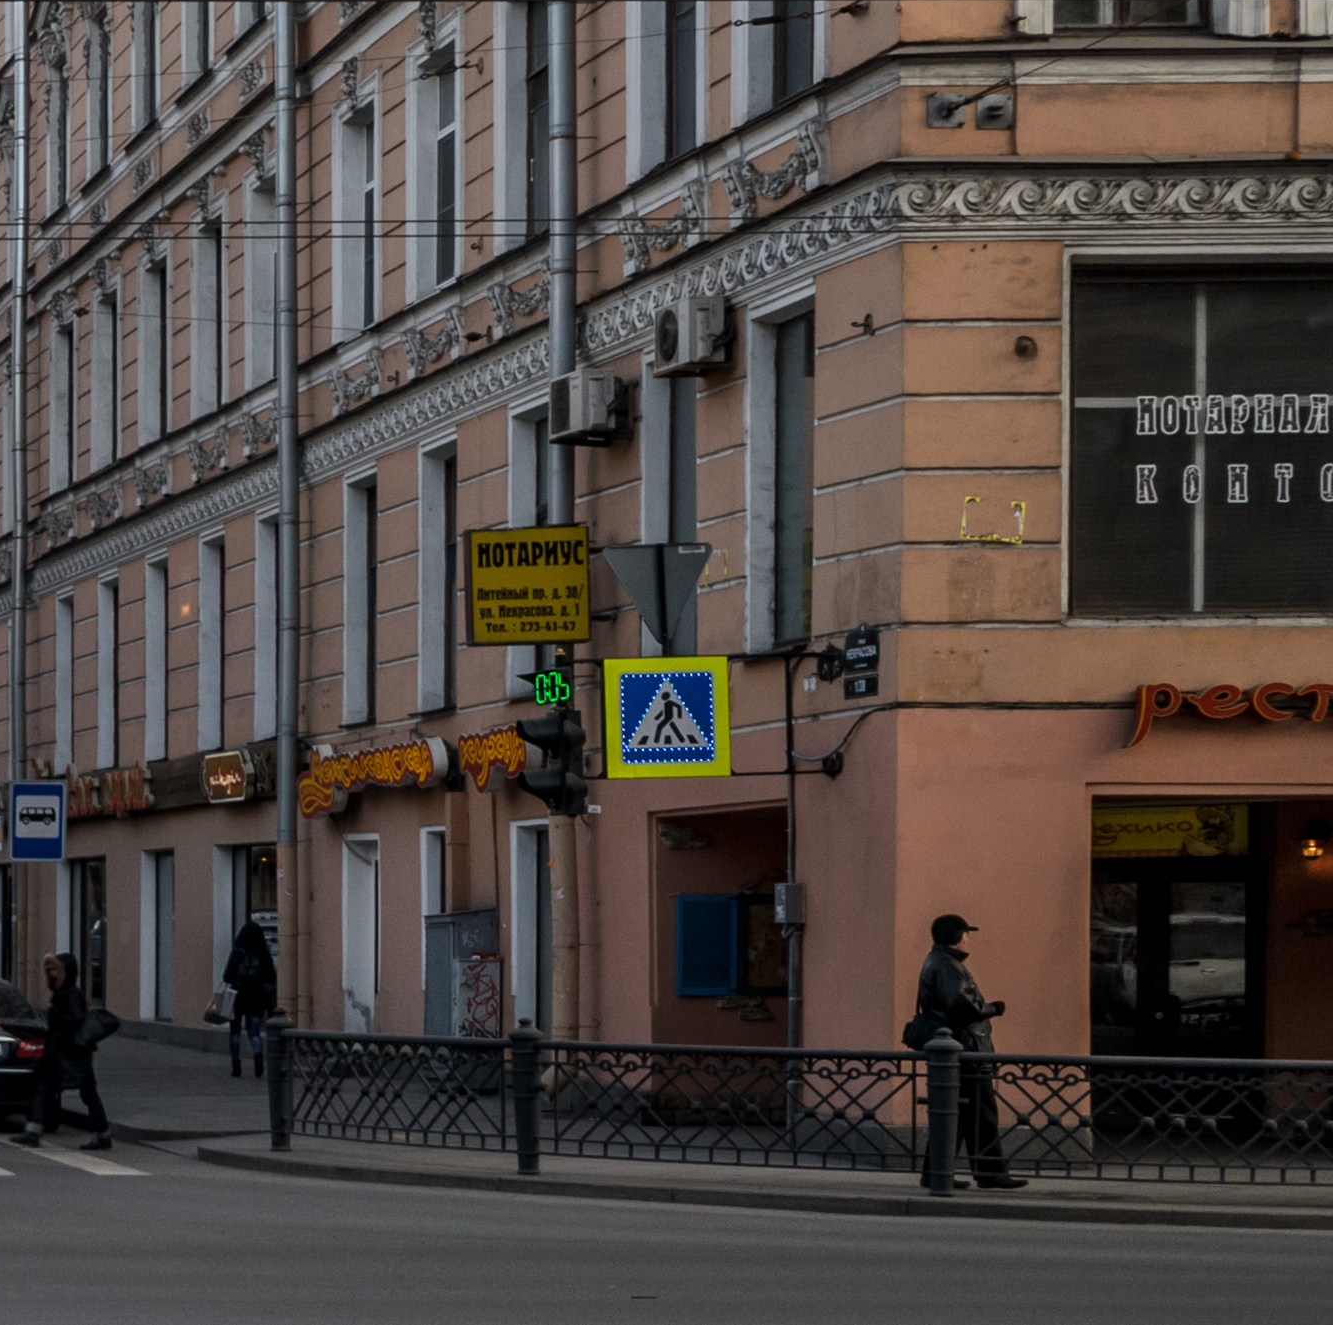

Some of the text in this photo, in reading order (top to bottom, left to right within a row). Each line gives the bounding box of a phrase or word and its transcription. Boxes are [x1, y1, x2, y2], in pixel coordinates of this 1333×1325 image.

[477, 539, 585, 568] НОТАРИУС
[477, 587, 529, 601] Литейный
[574, 602, 580, 616] 1
